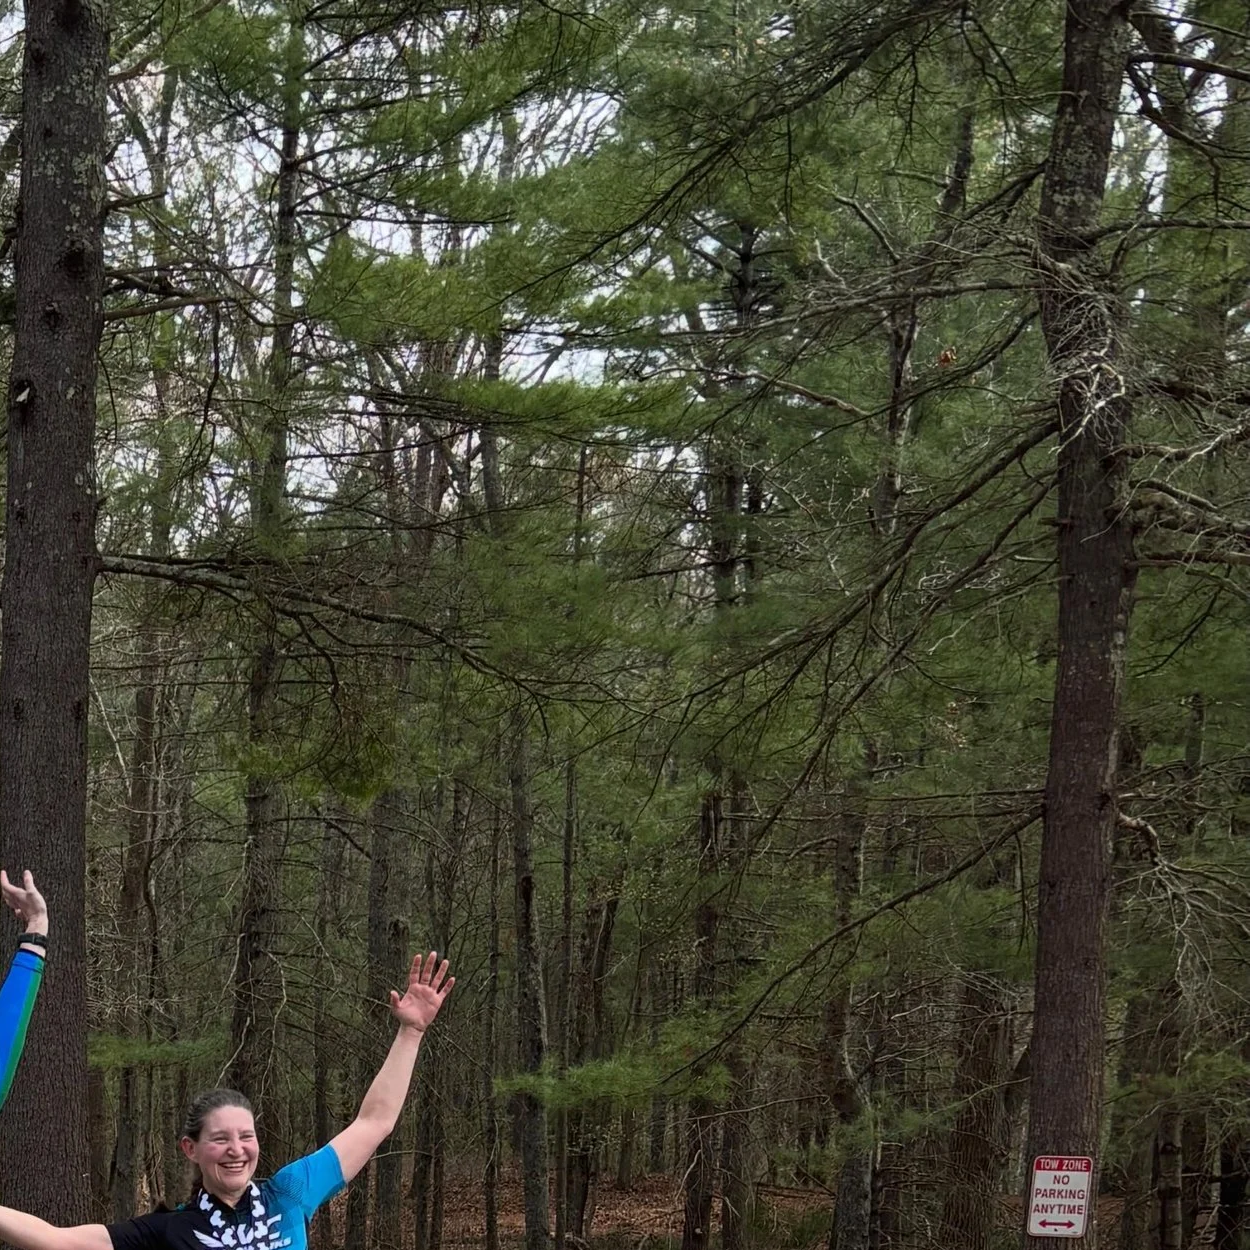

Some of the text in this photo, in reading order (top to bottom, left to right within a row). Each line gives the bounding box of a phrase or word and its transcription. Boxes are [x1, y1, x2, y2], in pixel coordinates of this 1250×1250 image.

[1040, 1159, 1088, 1171] TOW ZONE
[1053, 1175, 1070, 1185] NO
[1035, 1188, 1085, 1200] PARKING
[1033, 1203, 1084, 1215] ANYTIME
